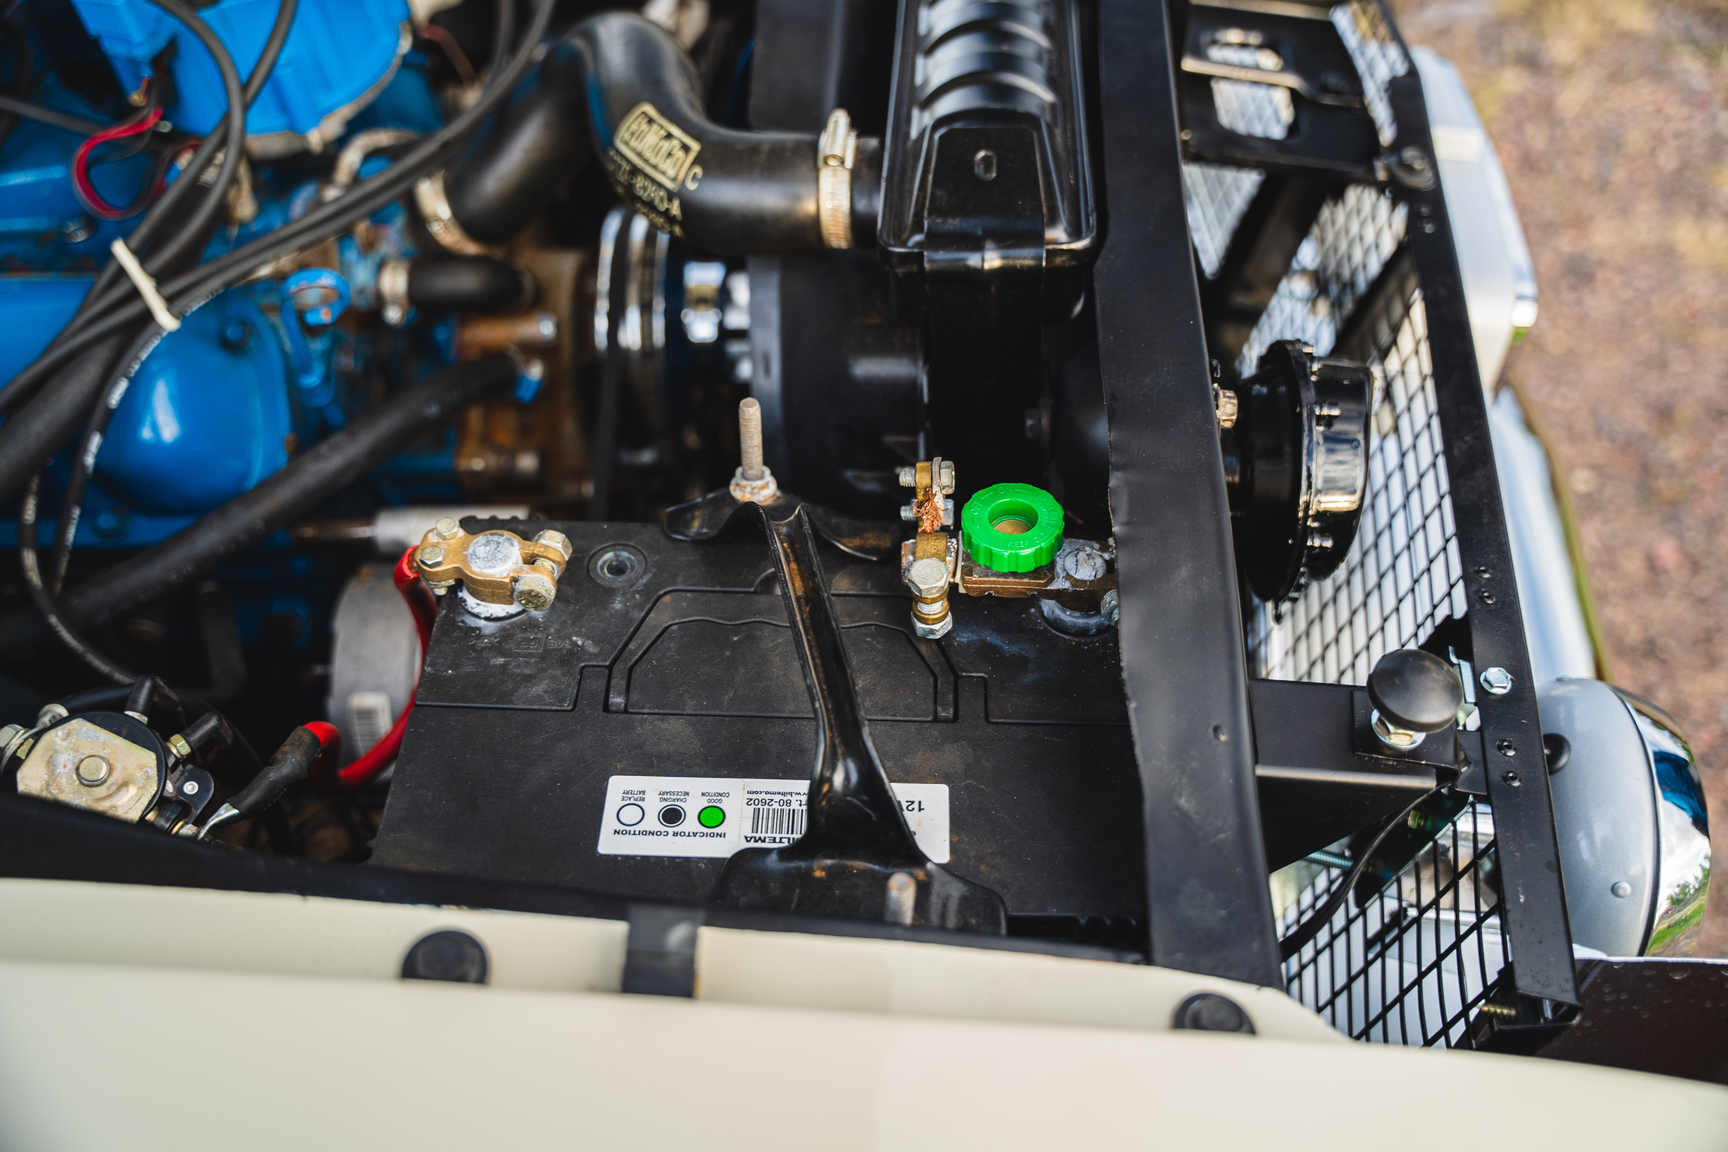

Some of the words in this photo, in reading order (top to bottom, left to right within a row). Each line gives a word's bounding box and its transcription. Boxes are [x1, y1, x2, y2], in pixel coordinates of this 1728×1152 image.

[685, 164, 703, 191] C
[997, 486, 1013, 495] ON
[969, 499, 983, 515] OFF
[746, 797, 792, 807] 80-2602
[613, 828, 669, 837] CONDITION
[671, 830, 727, 838] INDICATOR
[743, 835, 797, 844] ILTEMA
